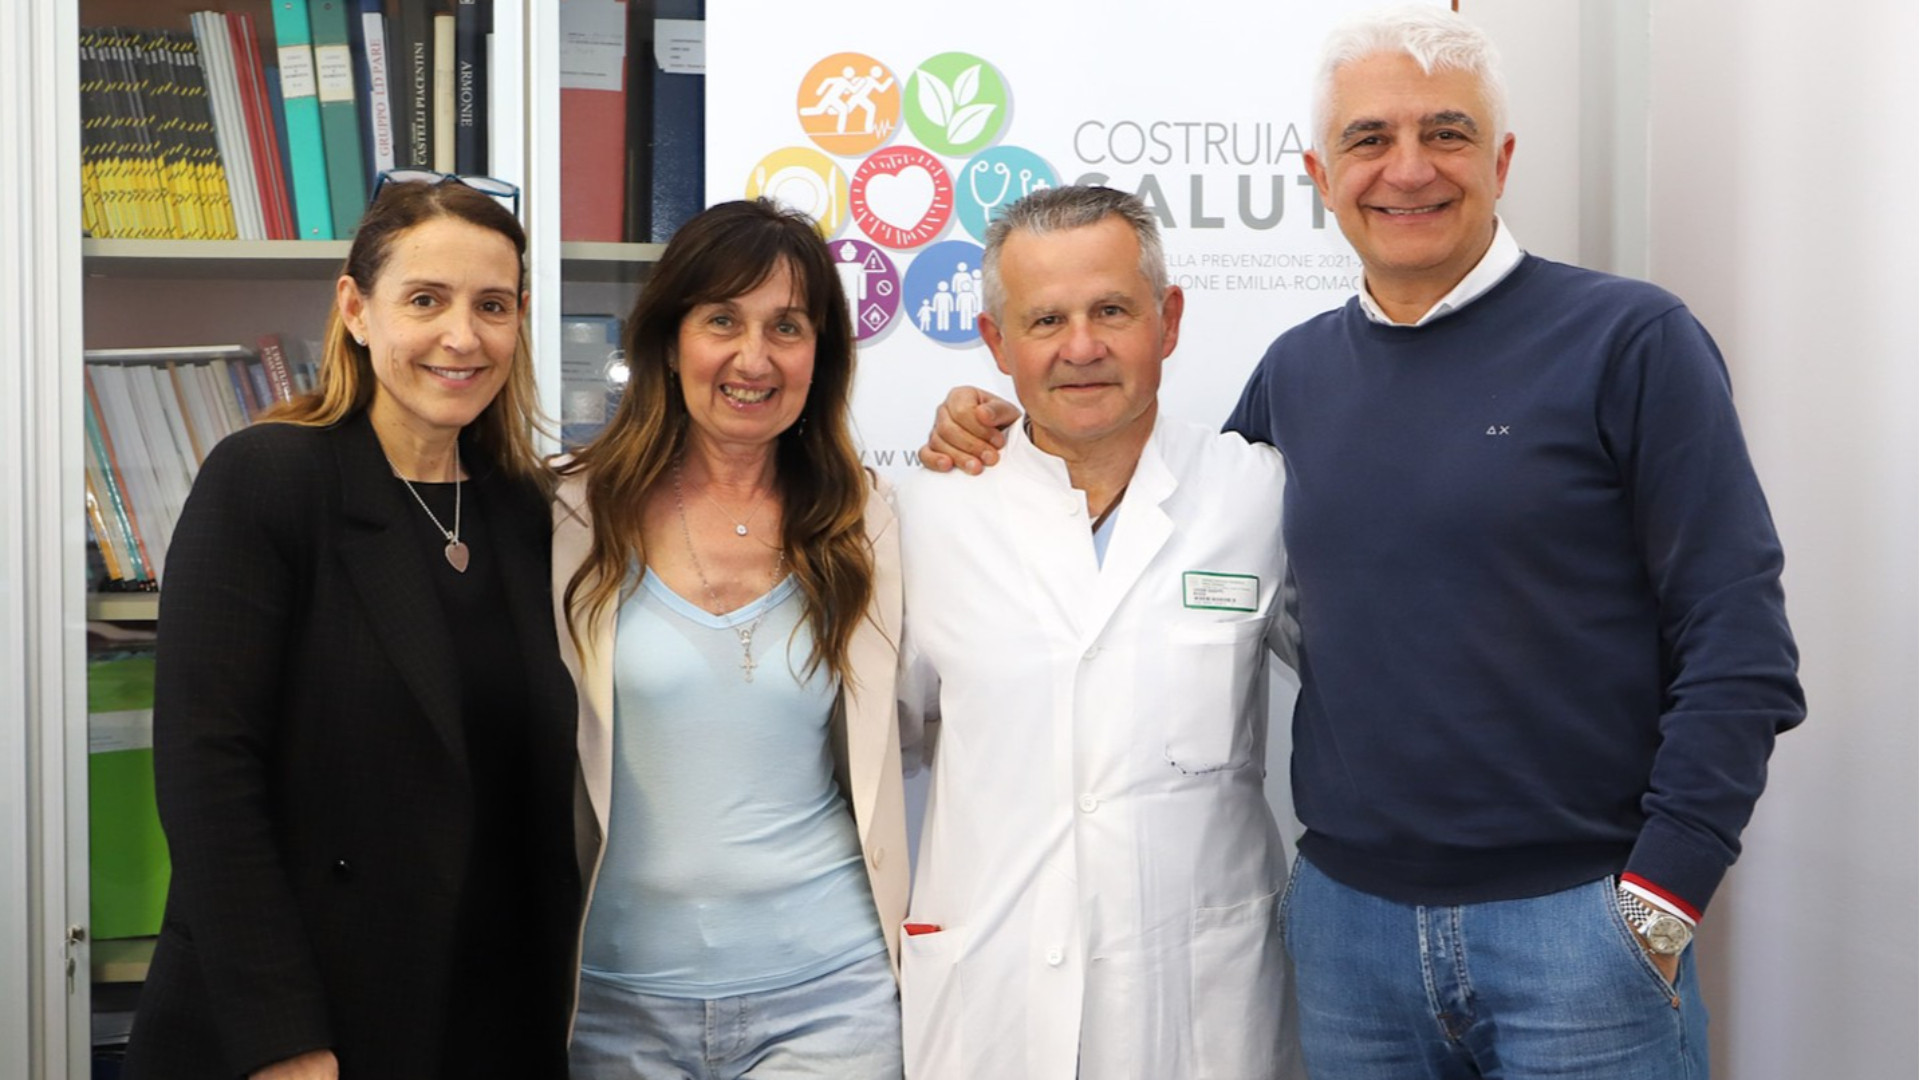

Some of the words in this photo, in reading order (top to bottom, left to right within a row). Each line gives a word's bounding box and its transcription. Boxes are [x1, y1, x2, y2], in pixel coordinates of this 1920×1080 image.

[414, 42, 426, 108] PIACENTINI
[460, 60, 474, 128] ARMONIE
[376, 102, 390, 157] GRUPPO
[415, 110, 428, 166] CASTELLI
[1073, 120, 1313, 165] COSTRUIA
[1073, 172, 1326, 230] ALUT
[1167, 274, 1220, 290] IONE
[1202, 254, 1313, 268] PREVENZIONE
[1318, 254, 1362, 268] 2021-
